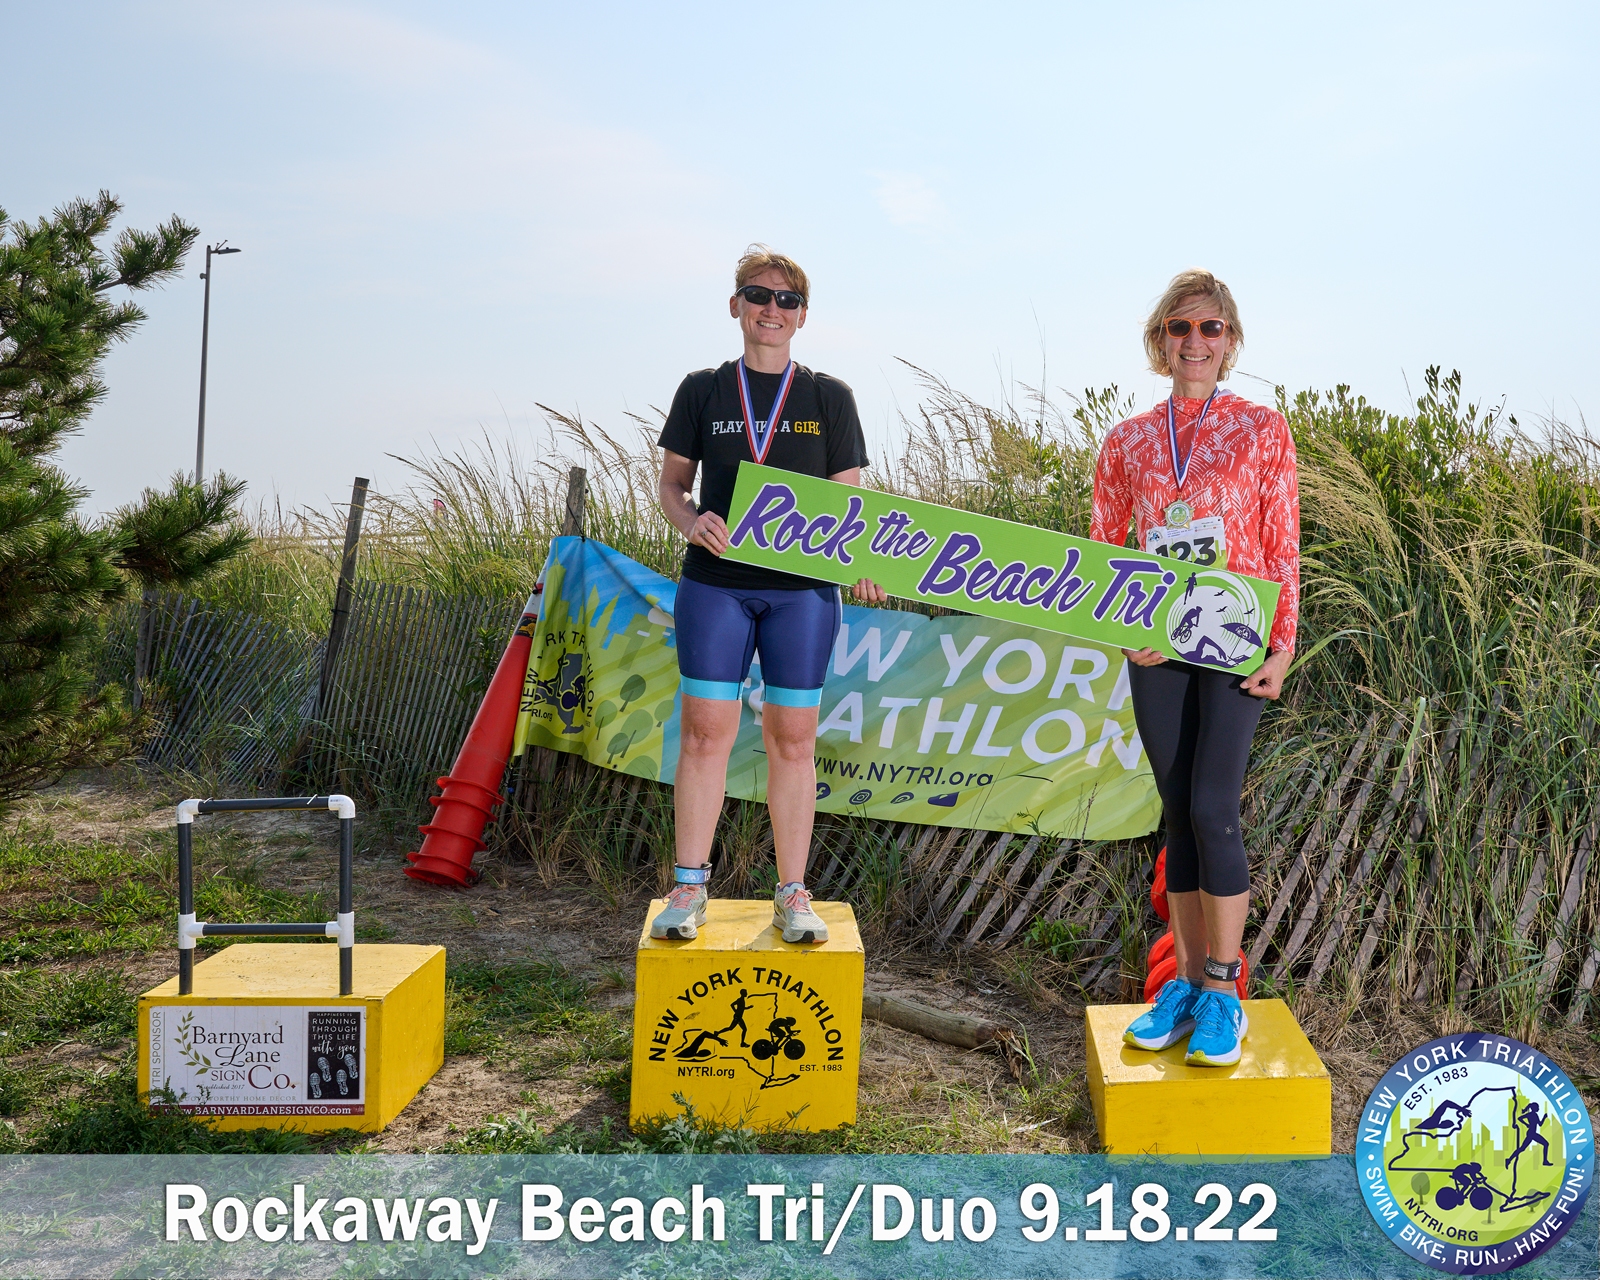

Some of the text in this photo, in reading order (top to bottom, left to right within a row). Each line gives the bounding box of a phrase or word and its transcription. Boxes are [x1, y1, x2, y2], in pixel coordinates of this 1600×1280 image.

[711, 420, 745, 435] PLAY
[780, 420, 791, 432] A
[794, 420, 821, 436] GIRL
[728, 483, 1177, 629] Rock the Beach Tri
[744, 676, 1144, 770] ATHLON
[649, 966, 844, 1062] NEW YORK TRIATHLON
[152, 1011, 161, 1064] SPONSOR
[192, 1025, 284, 1046] Barnyard
[312, 1025, 358, 1033] THROUGH
[336, 1033, 356, 1041] LIFE
[214, 1043, 281, 1068] Lane
[311, 1040, 358, 1060] with you
[211, 1065, 297, 1090] SIGN Co.
[677, 1066, 735, 1079] NYTRI.org
[799, 1064, 843, 1072] EST. 1983
